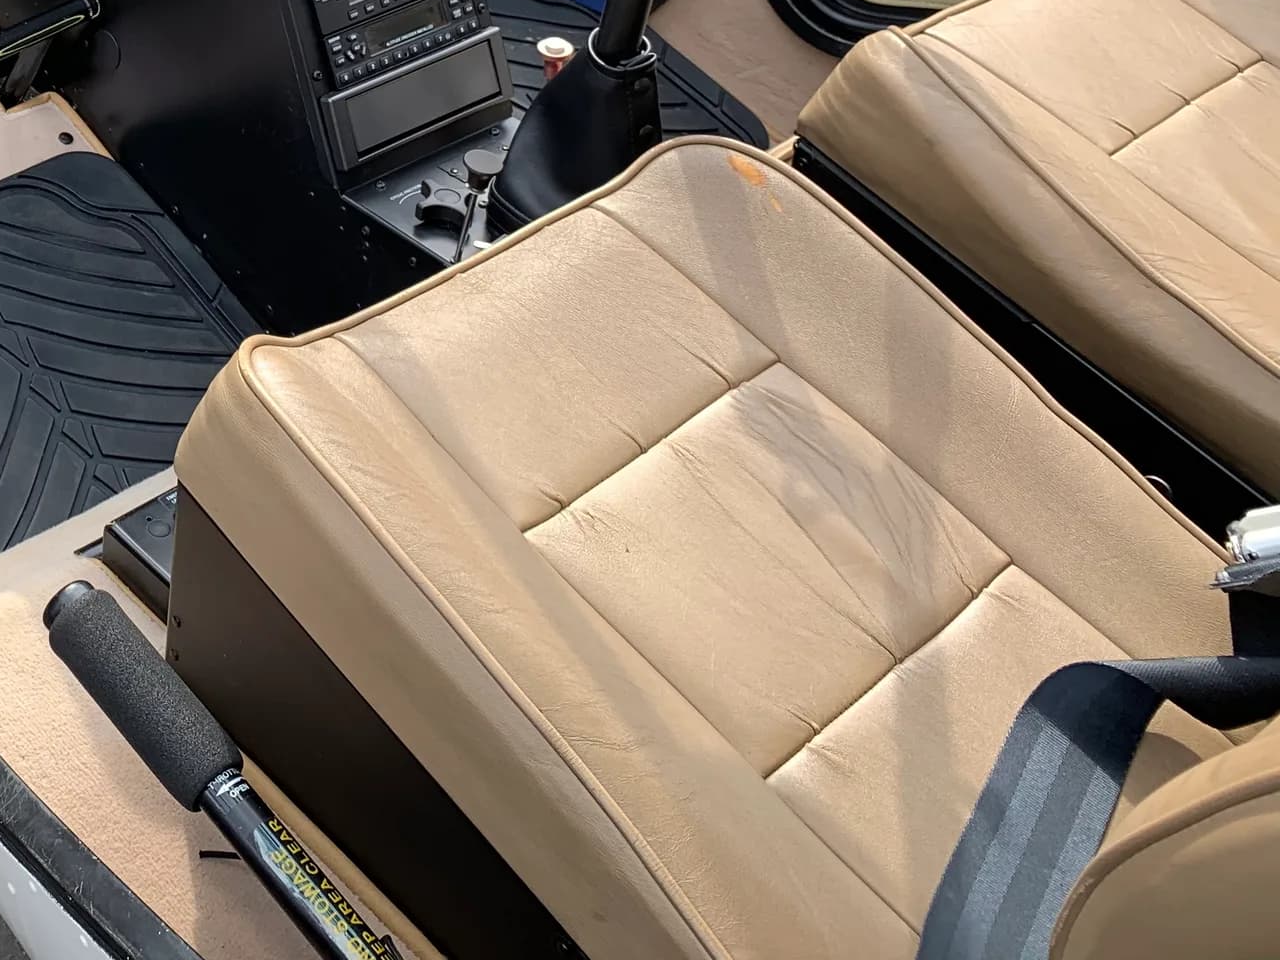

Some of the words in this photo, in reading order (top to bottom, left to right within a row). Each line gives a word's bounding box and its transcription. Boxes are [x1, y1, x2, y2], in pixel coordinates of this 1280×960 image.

[229, 782, 250, 798] OPEN
[267, 818, 320, 875] CLEAR
[320, 877, 365, 926] AREA
